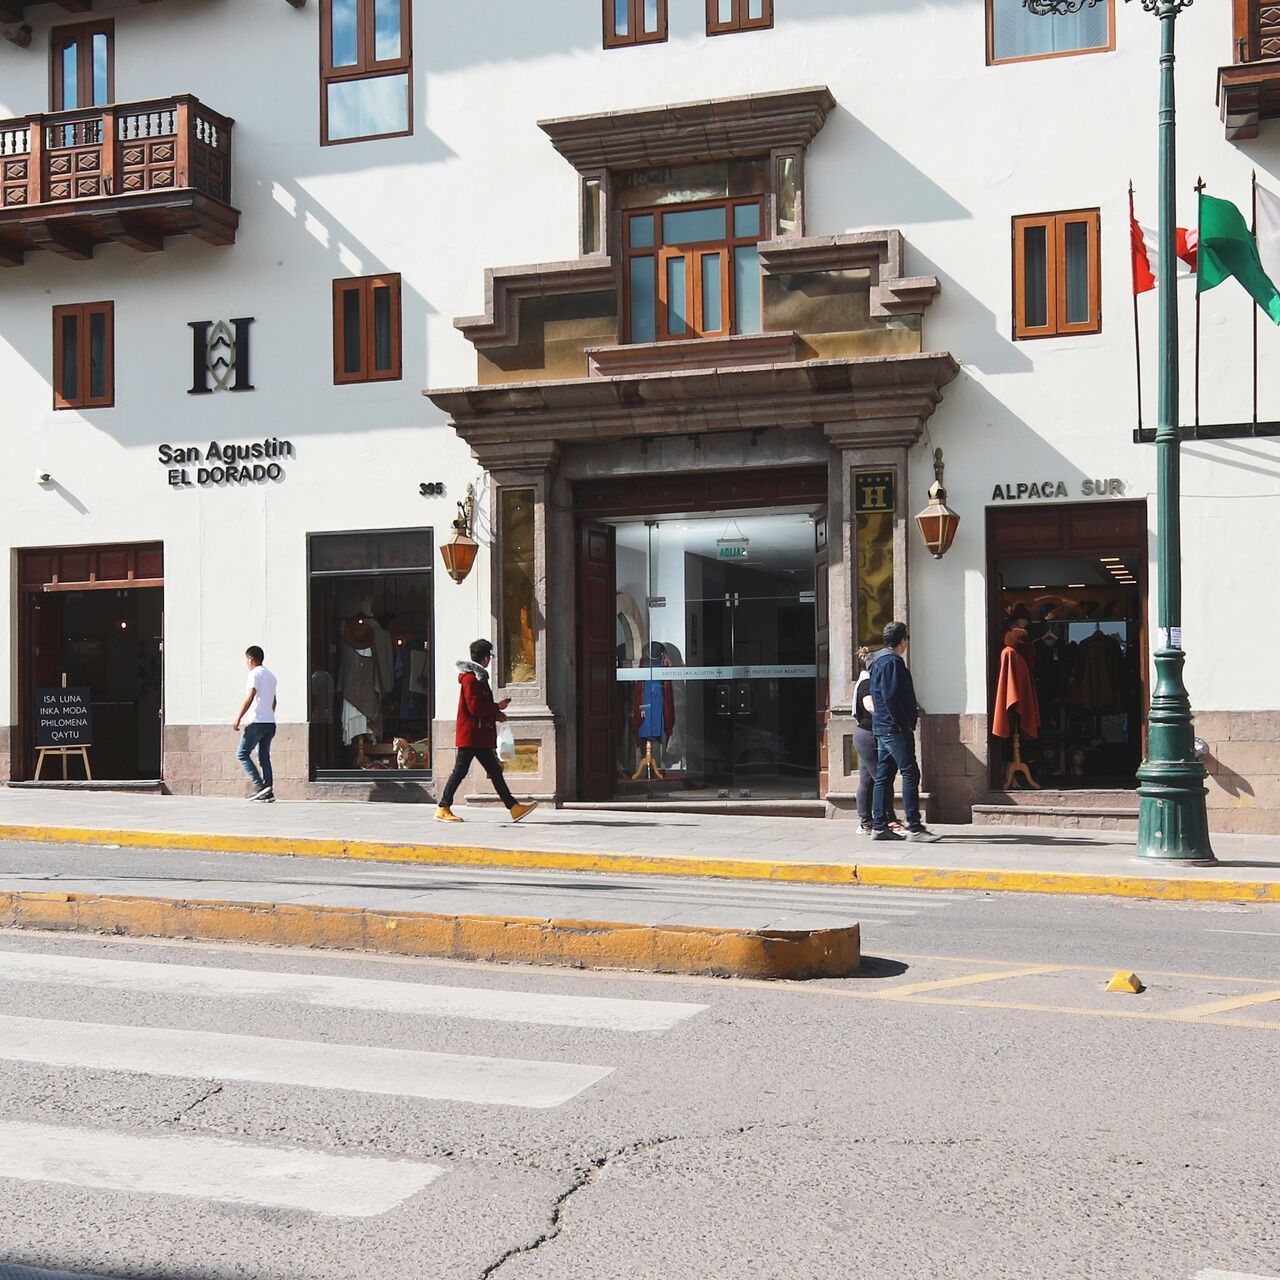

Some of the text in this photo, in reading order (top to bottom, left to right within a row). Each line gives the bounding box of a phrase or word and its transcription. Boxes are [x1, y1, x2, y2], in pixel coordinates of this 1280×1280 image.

[158, 437, 292, 465] San Agustin
[168, 463, 281, 485] EL DORADO
[419, 482, 443, 496] 395
[992, 478, 1123, 501] ALPACA SUR
[862, 486, 887, 507] H
[60, 695, 81, 703] LUNA
[40, 706, 87, 715] INKA MODA
[41, 718, 87, 726] PHILOMENA
[51, 731, 79, 741] QAYTU
